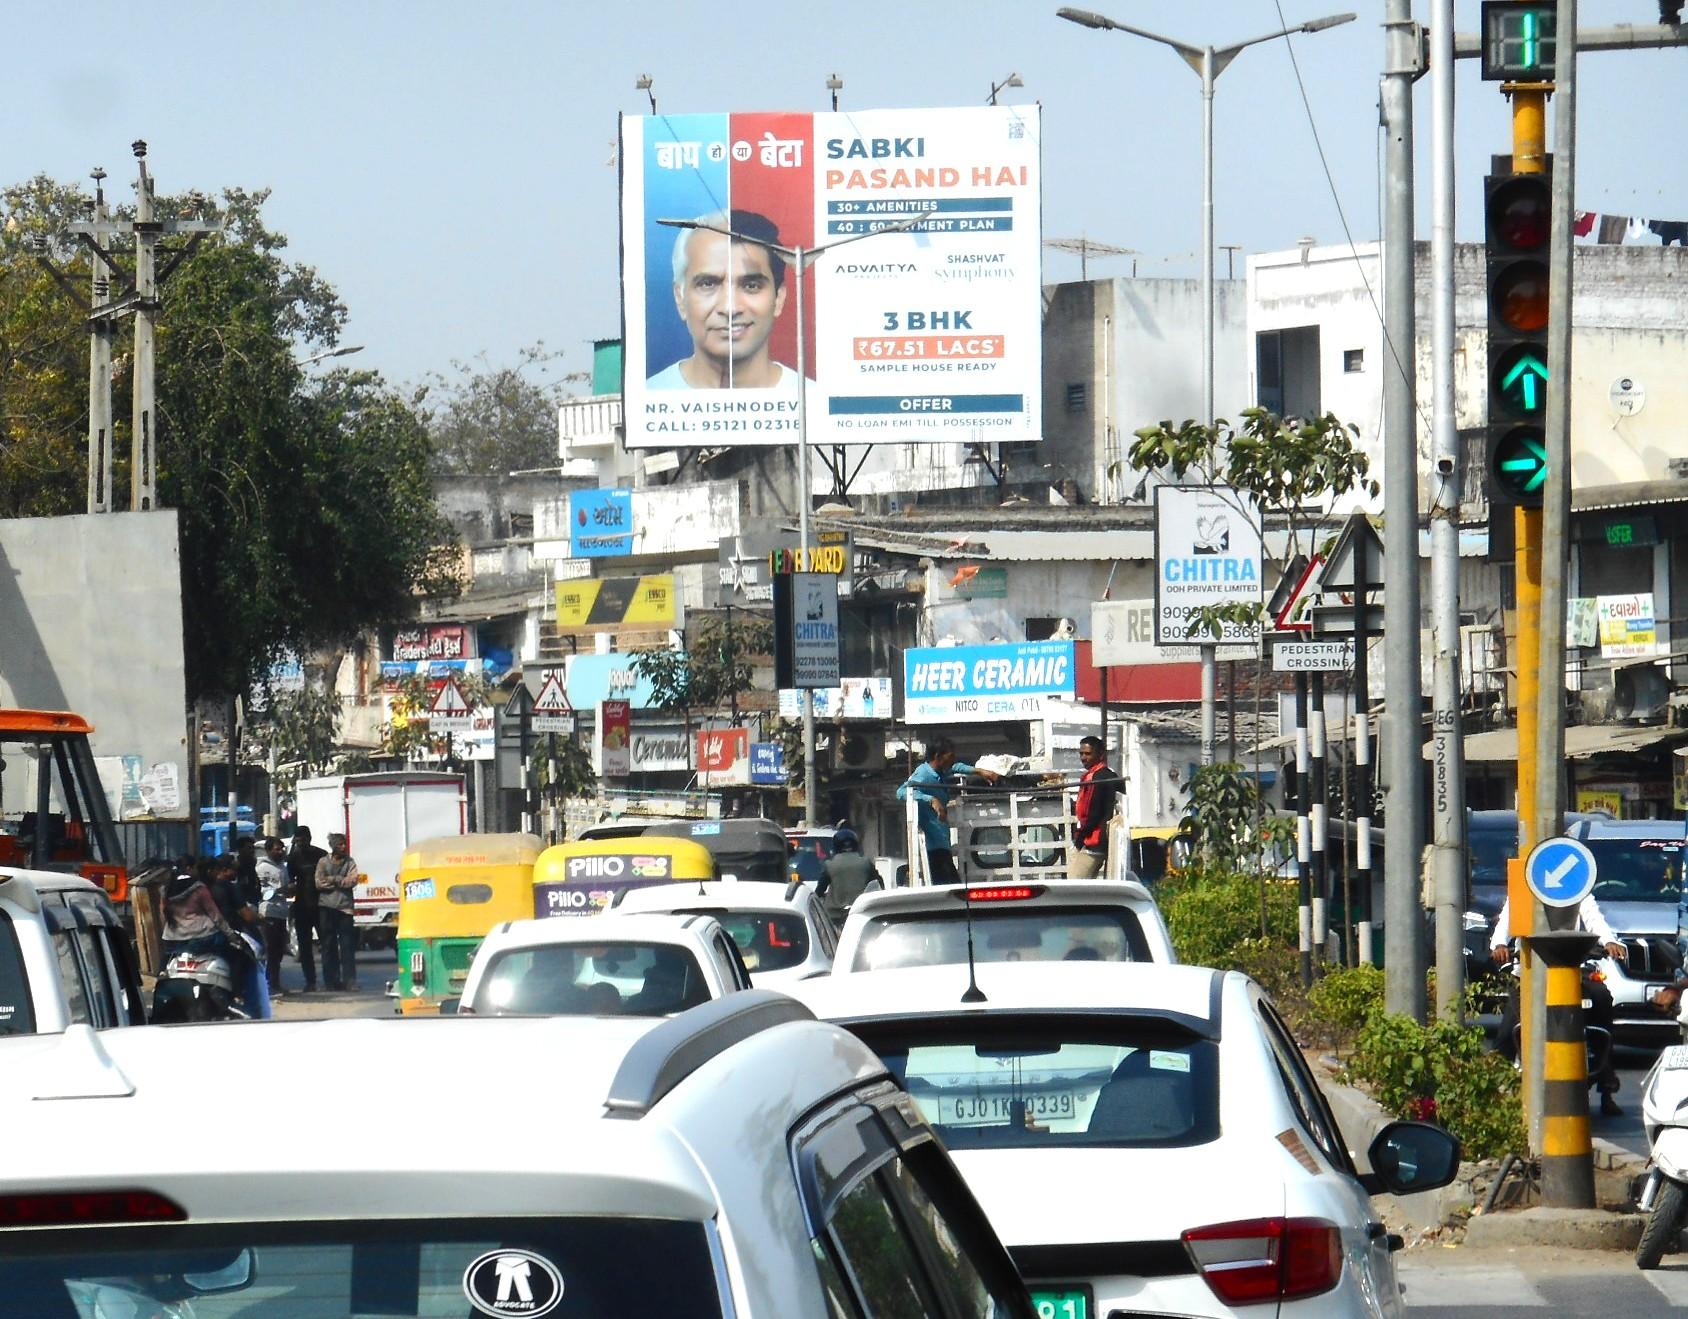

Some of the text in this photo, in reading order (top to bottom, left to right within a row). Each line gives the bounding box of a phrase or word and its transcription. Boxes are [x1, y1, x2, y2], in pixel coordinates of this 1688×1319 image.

[654, 141, 703, 169] बाप
[757, 131, 804, 168] बेटा
[826, 137, 925, 159] SABKI
[826, 166, 1028, 189] PASAND HAI
[836, 200, 938, 213] 30+ AMENITIES
[837, 221, 854, 232] 40
[960, 219, 995, 230] PLAN
[947, 253, 1006, 264] SHASHVAT
[883, 310, 973, 331] 3 BHK
[860, 362, 997, 373] SAMPLE HOUSE READY
[645, 401, 798, 414] NR. VAISHNODEV
[899, 398, 952, 411] OFFER
[646, 421, 696, 432] CALL:
[702, 420, 748, 431] 95121
[837, 420, 853, 428] NO
[858, 420, 888, 428] LOAN
[892, 419, 912, 427] EMI
[917, 419, 940, 427] TILL
[1164, 558, 1256, 582] CHITRA
[1166, 584, 1258, 593] OOH PRIVATE LIMITED
[796, 623, 835, 640] CHITRA
[1281, 645, 1354, 654] PEDESTRIAN
[1287, 658, 1349, 668] CROSSING
[912, 655, 1068, 692] HEER CERAMIC
[955, 700, 978, 713] NITCO
[987, 701, 1016, 713] CERA
[1436, 737, 1447, 812] 32835
[366, 886, 396, 897] HORN
[955, 1094, 1071, 1119] GJ01K0339
[493, 1300, 536, 1310] ADVOCATE
